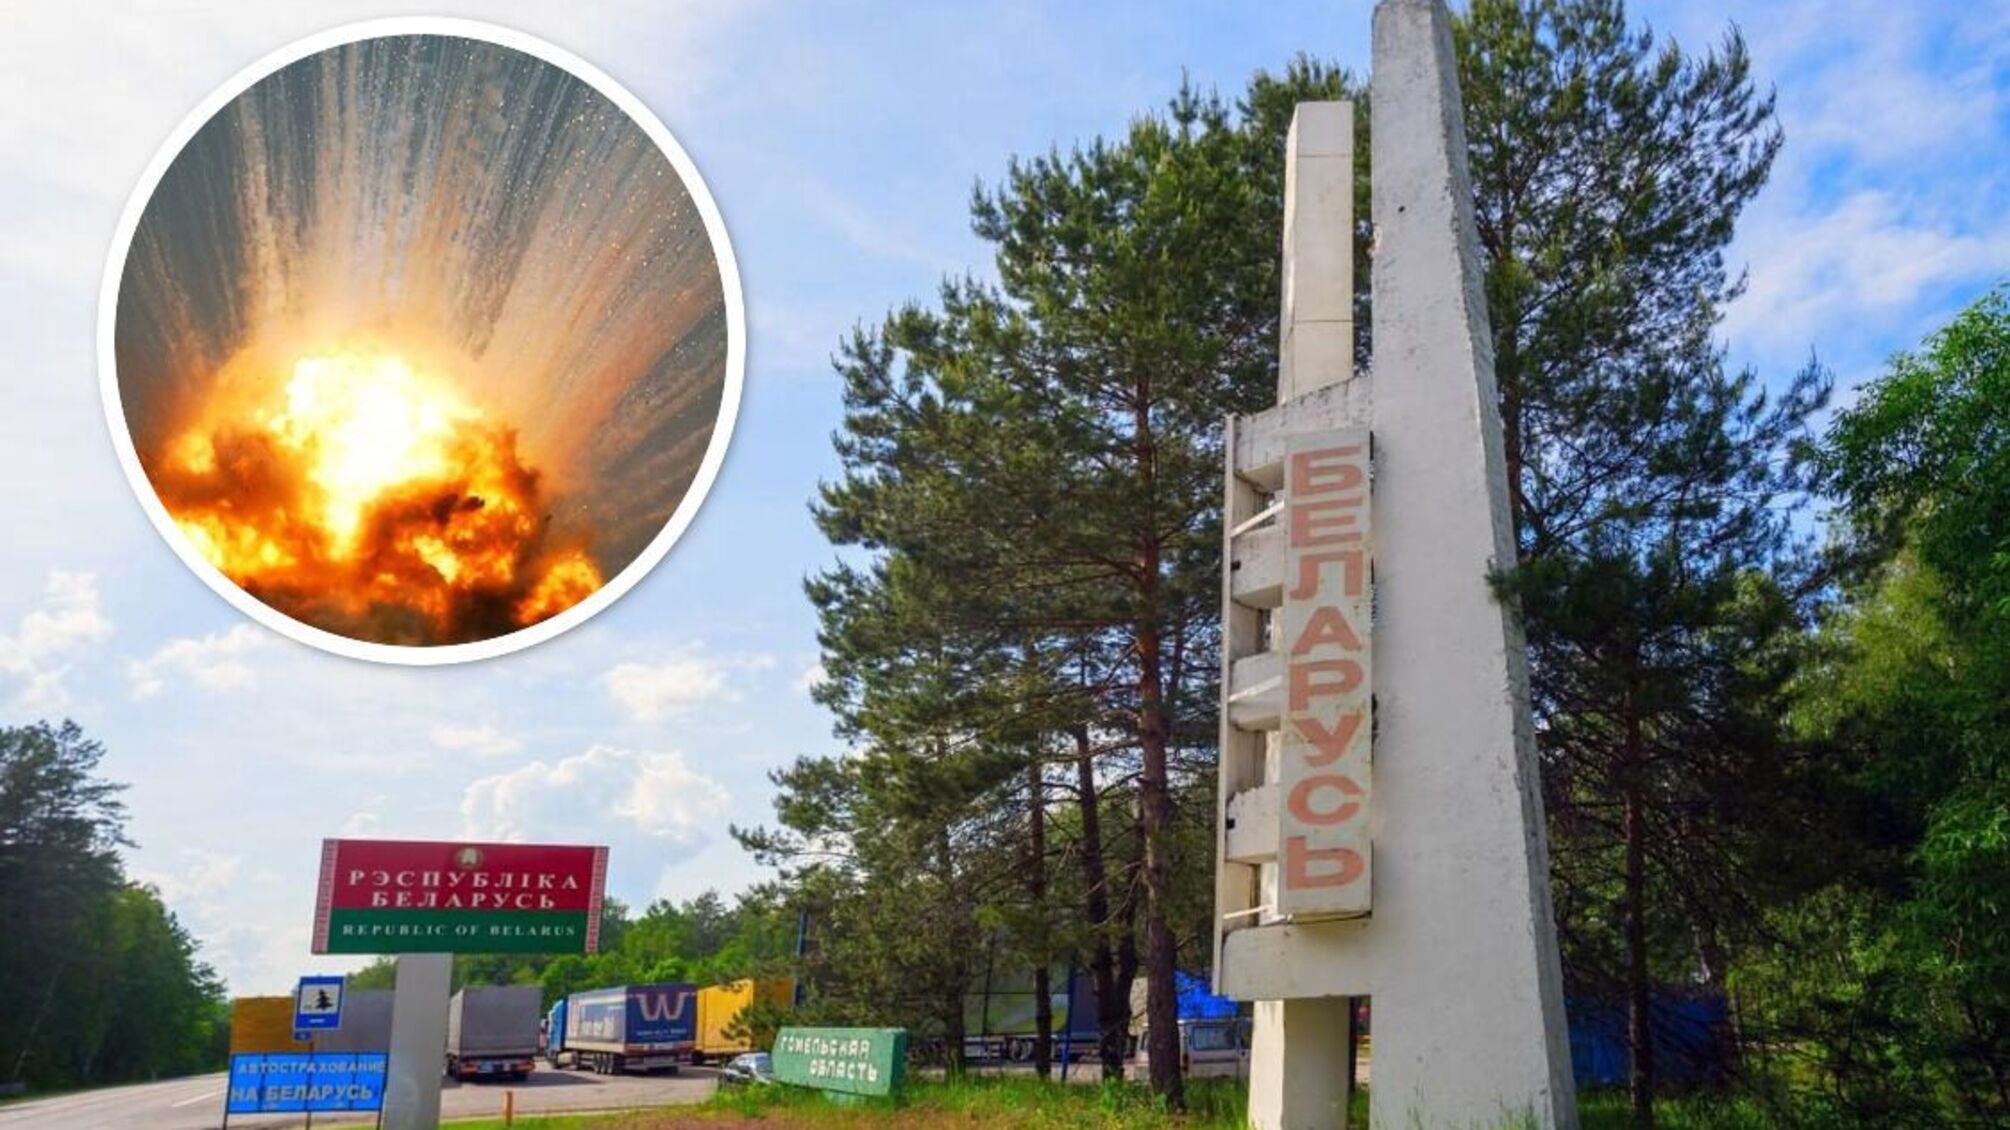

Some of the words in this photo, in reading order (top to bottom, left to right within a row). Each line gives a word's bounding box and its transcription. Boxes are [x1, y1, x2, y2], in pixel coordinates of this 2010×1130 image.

[1287, 445, 1365, 890] БЕЛАРУСЬ
[348, 869, 578, 889] РЭСПУБЛІКА
[371, 891, 556, 909] БЕЛАРУСЬ
[342, 923, 448, 936] REPUBLIC
[455, 924, 479, 936] OF
[489, 924, 576, 936] BELARUS
[780, 1035, 871, 1060] ГОМЕЛЬСКАЯ
[809, 1059, 878, 1082] ОБЛАСТЬ
[230, 1086, 259, 1102] НА
[264, 1083, 373, 1101] БЕЛАРУСЬ
